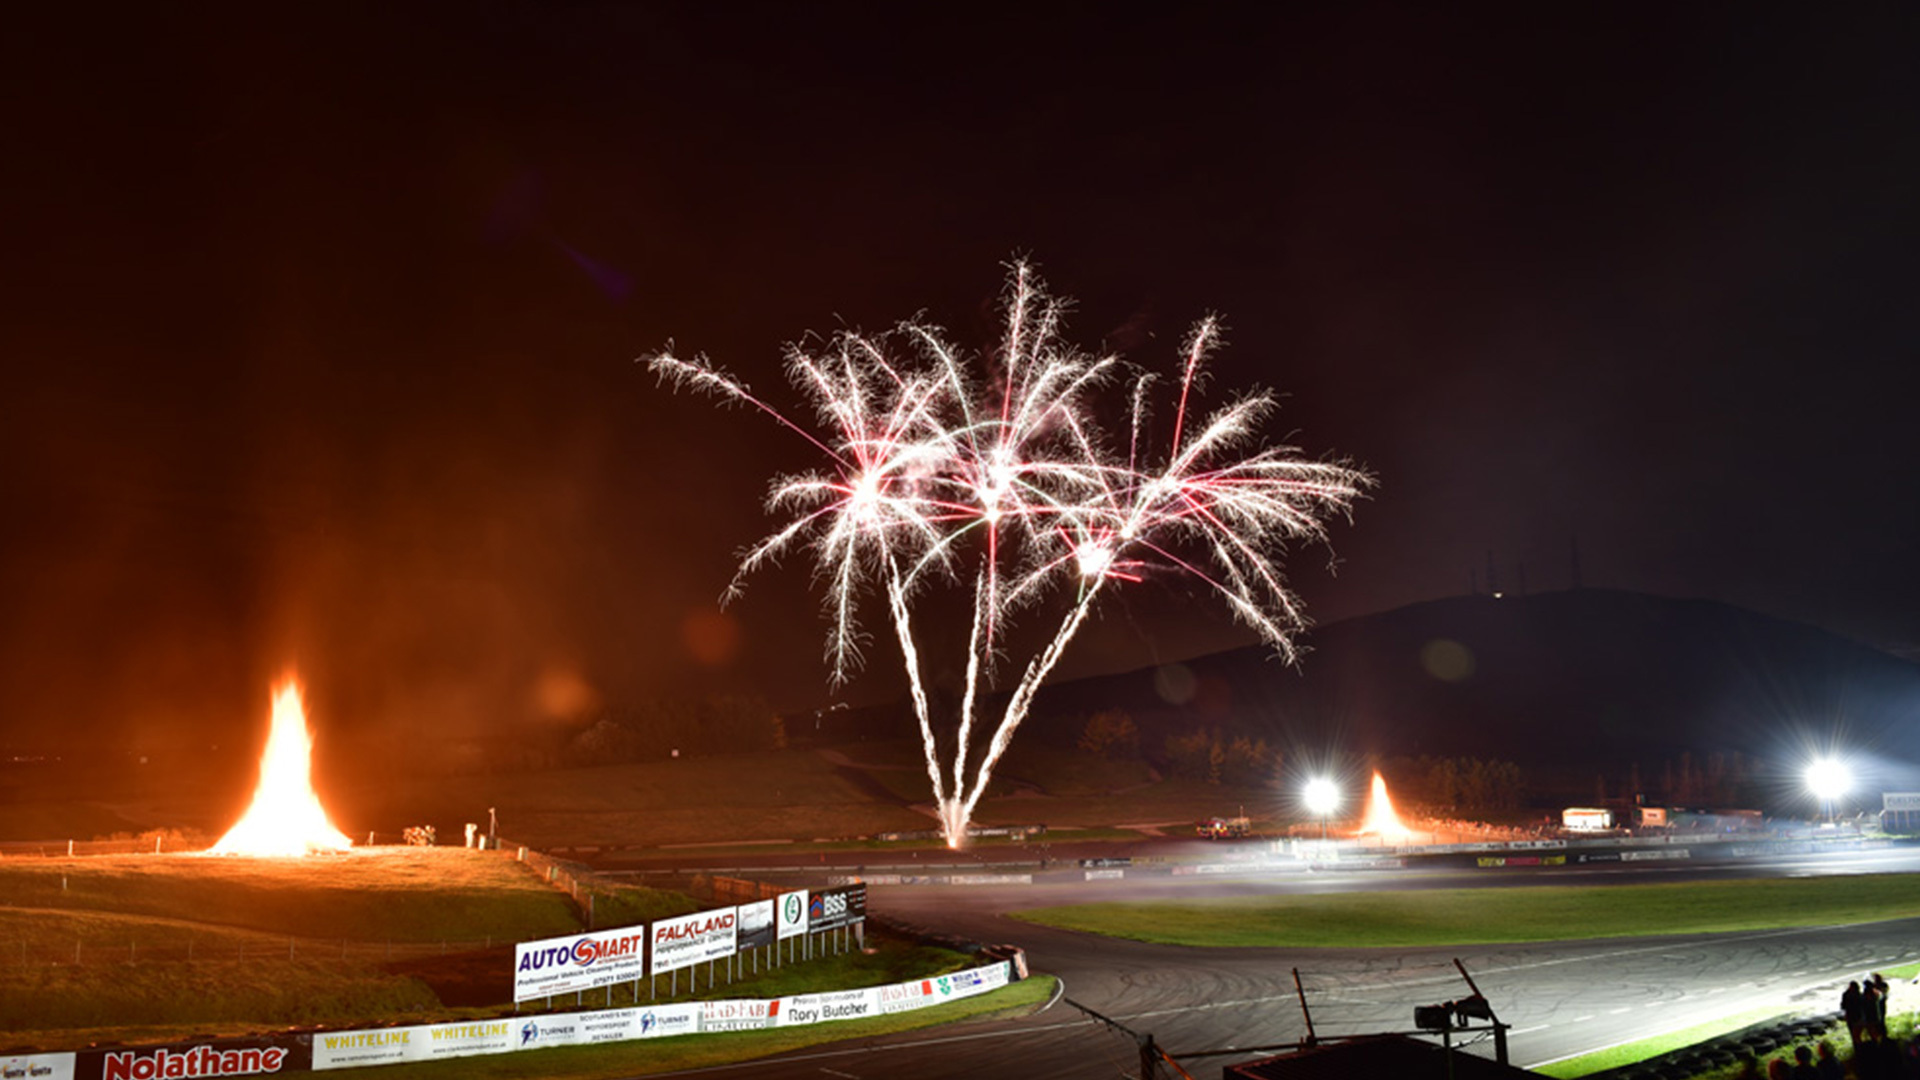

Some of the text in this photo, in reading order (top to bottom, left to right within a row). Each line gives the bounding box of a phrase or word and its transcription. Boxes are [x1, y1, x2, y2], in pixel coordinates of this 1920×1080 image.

[656, 914, 734, 943] FALKLAND
[519, 935, 641, 972] AUTOSMART
[518, 973, 559, 986] Professional
[586, 964, 613, 976] Cleaning
[657, 1015, 690, 1025] TURNER
[789, 1003, 869, 1023] Rory Butcher
[325, 1031, 410, 1049] WHITELINE
[431, 1022, 509, 1041] WHITELINE
[540, 1026, 575, 1036] TURNER
[105, 1046, 287, 1080] Nolathane
